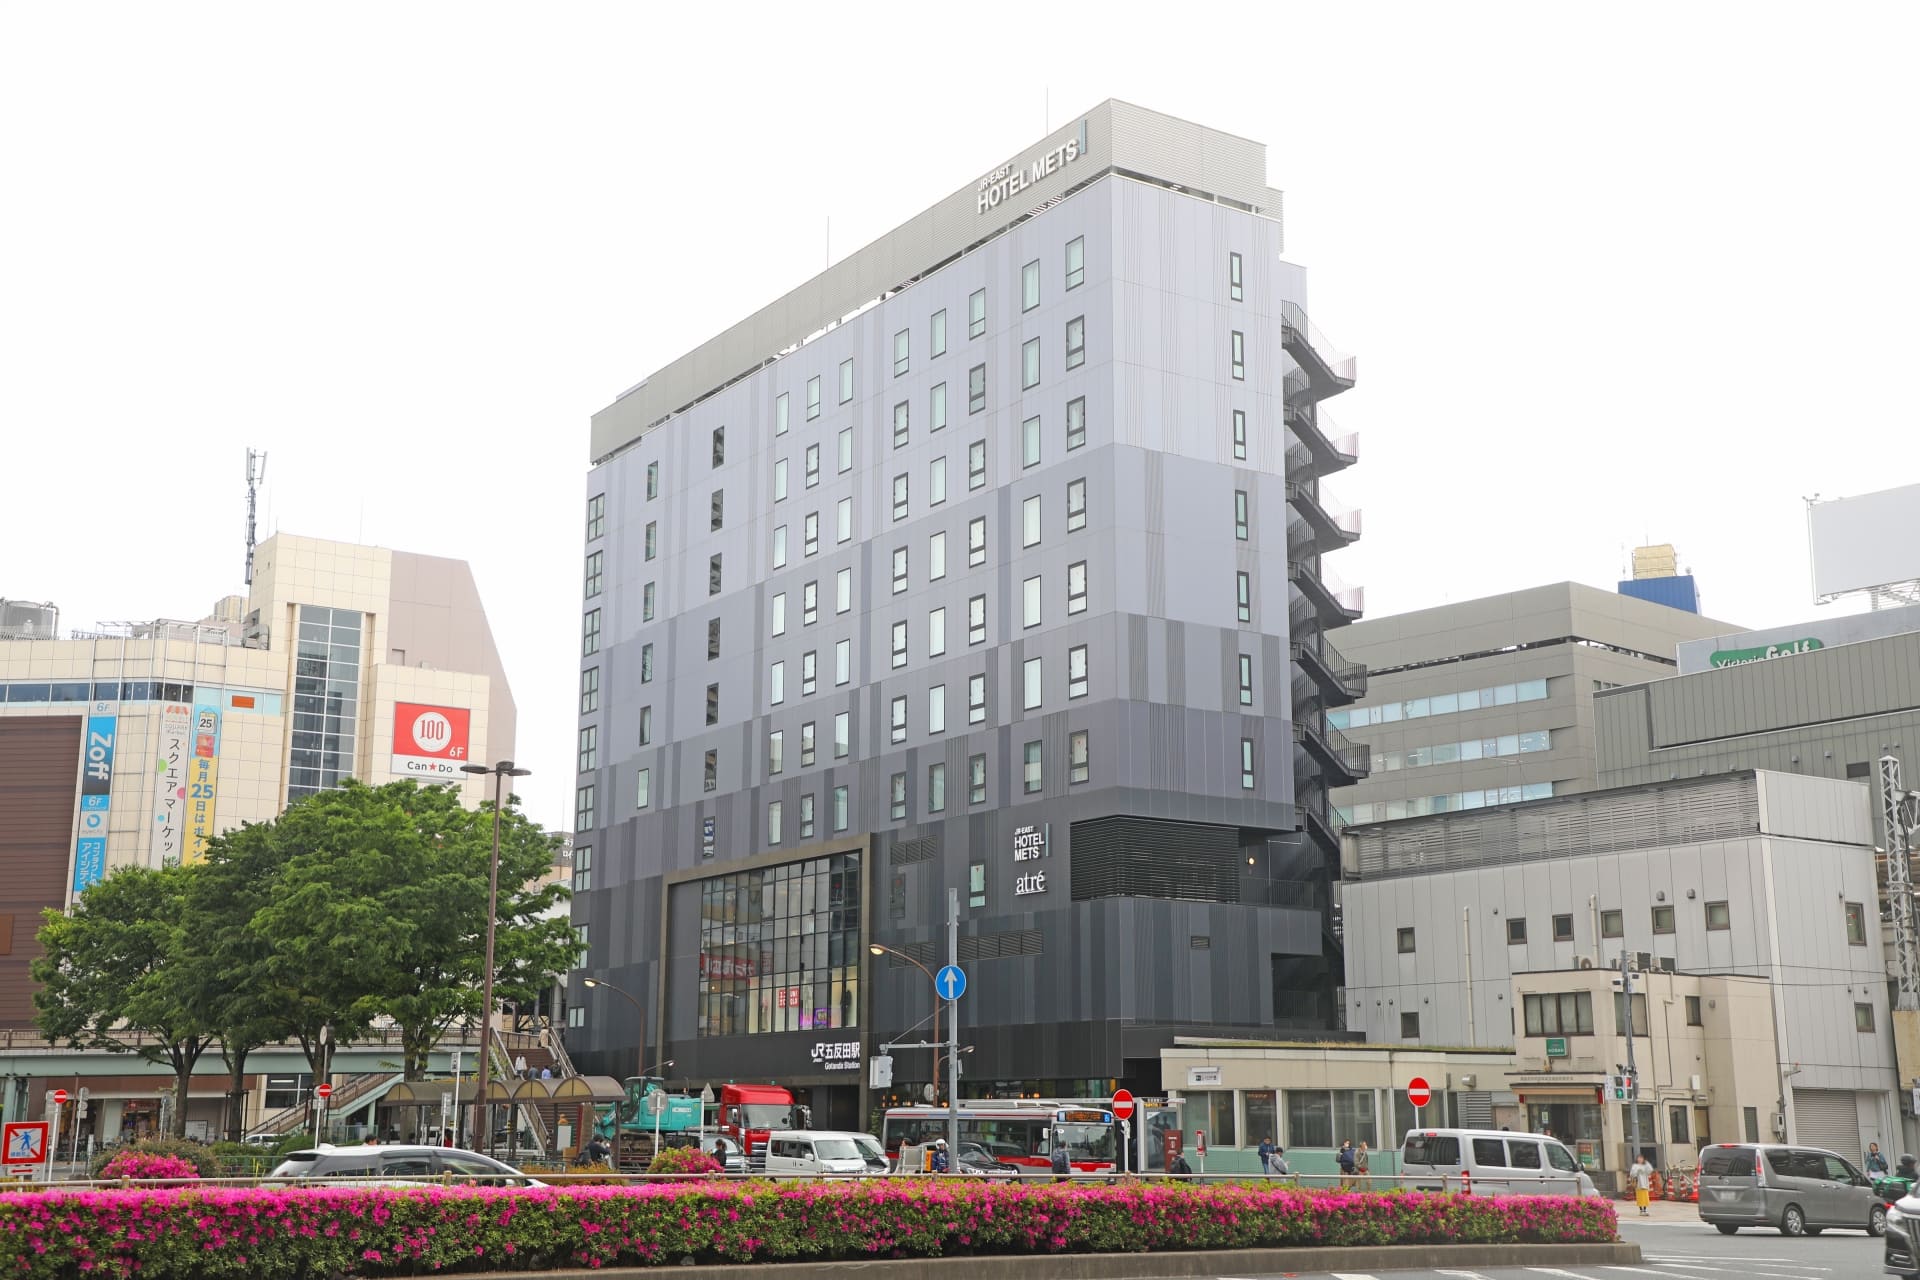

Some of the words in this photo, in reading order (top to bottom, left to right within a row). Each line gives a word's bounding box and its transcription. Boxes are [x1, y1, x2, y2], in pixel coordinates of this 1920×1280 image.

[978, 169, 1029, 214] HOTEL
[1032, 139, 1078, 182] METS
[200, 718, 213, 728] 25
[420, 719, 444, 740] 100
[87, 731, 112, 780] Zoff
[449, 746, 464, 757] 6F
[1014, 832, 1045, 848] HOTEL
[1014, 846, 1039, 862] METS
[1016, 870, 1045, 893] atré
